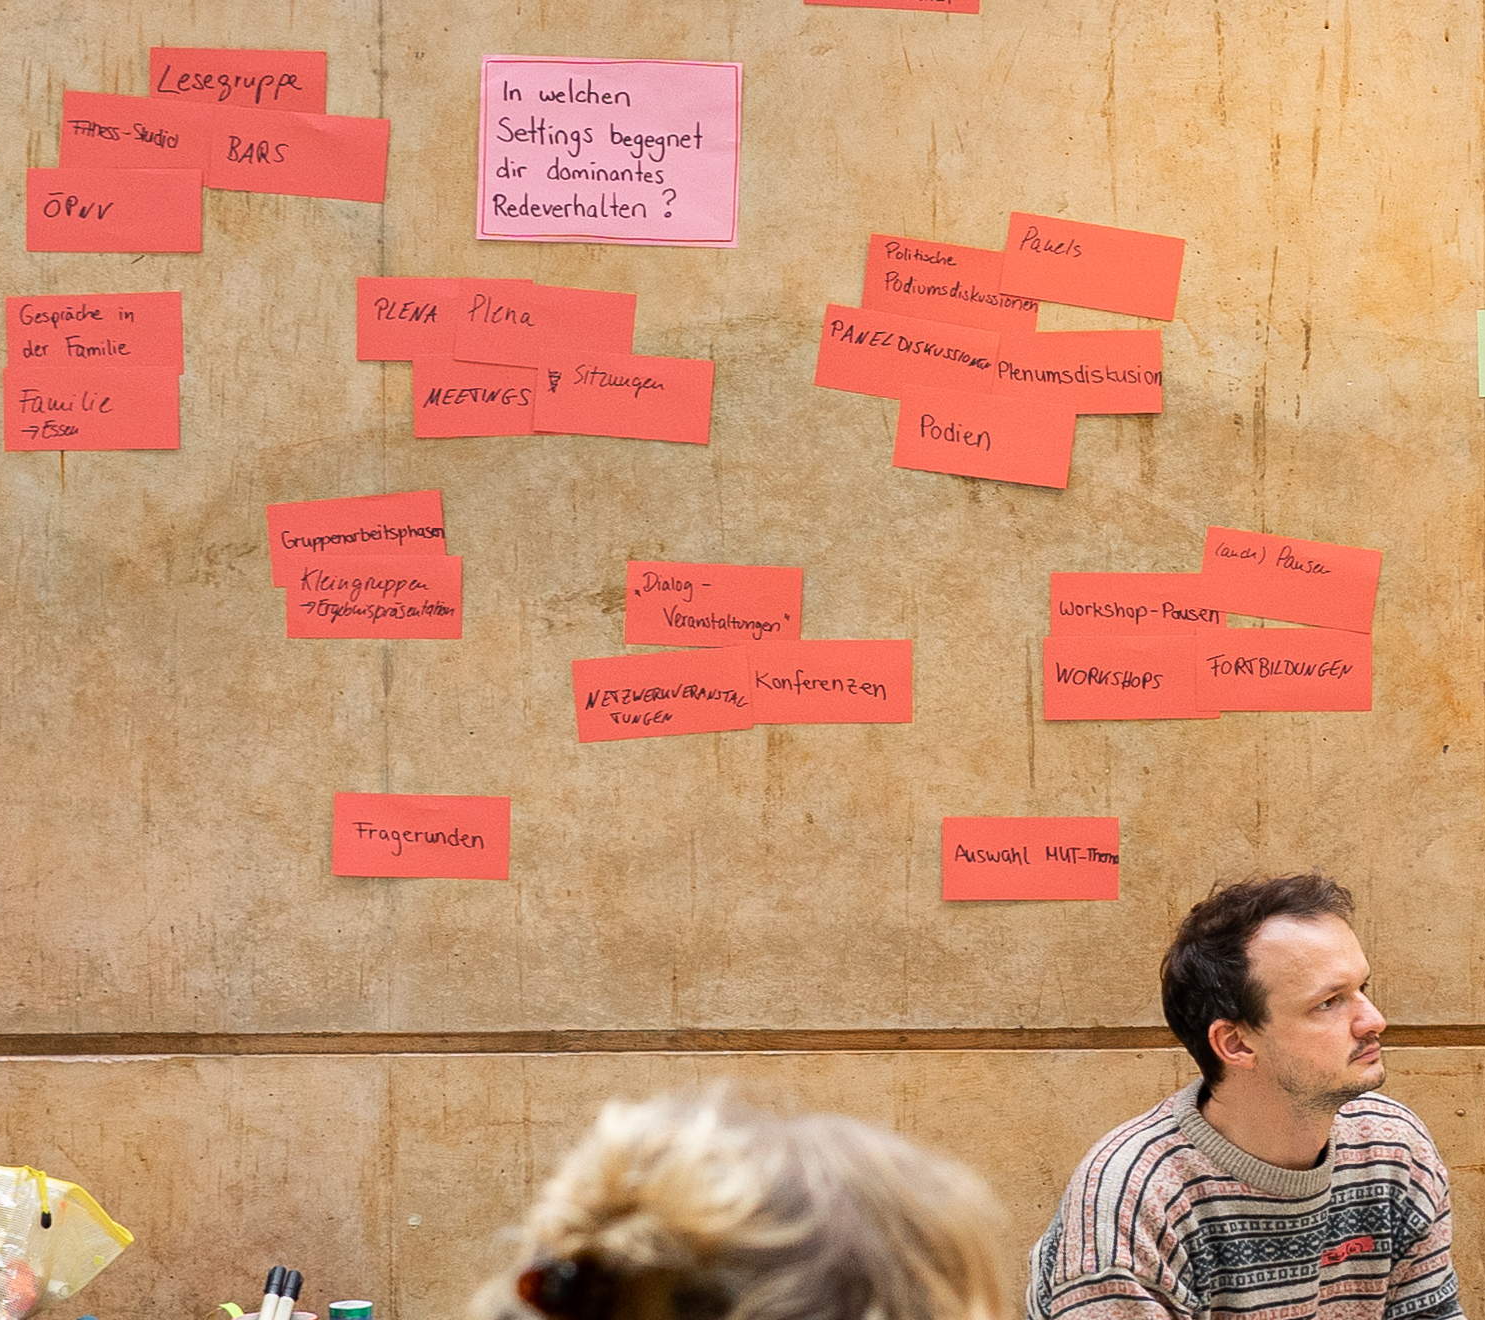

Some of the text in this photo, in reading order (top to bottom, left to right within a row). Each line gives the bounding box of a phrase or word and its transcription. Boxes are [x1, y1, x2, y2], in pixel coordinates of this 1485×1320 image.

[157, 64, 303, 105] Lesegruppe
[503, 77, 631, 108] In welchen
[496, 115, 703, 167] Settings begegnet
[496, 152, 665, 185] dir dominantes
[492, 192, 647, 219] Redeverhalten
[884, 241, 957, 267] Politische
[1019, 225, 1082, 258] Panels
[884, 270, 1044, 314] Podiumsdiskussionen
[19, 303, 135, 330] Gespräche in
[374, 297, 438, 324] PLENA
[467, 293, 535, 327] Plena
[22, 334, 131, 359] der Familie
[573, 363, 665, 399] Sitzungen
[18, 388, 113, 414] Familie
[422, 387, 532, 409] MEETINGS
[920, 413, 991, 452] Podien
[281, 520, 450, 553] Gruppenarbeitsphasen
[1275, 545, 1332, 575] Pausen
[300, 566, 430, 604] Kleingruppen
[1055, 662, 1164, 690] WORKSHOPS
[1206, 653, 1354, 680] FORTBILDUNGEN
[755, 669, 887, 701] Konferenzen
[609, 709, 673, 726] TUNGEN
[352, 821, 485, 857] Fragerunden
[954, 844, 1031, 866] Auswahl
